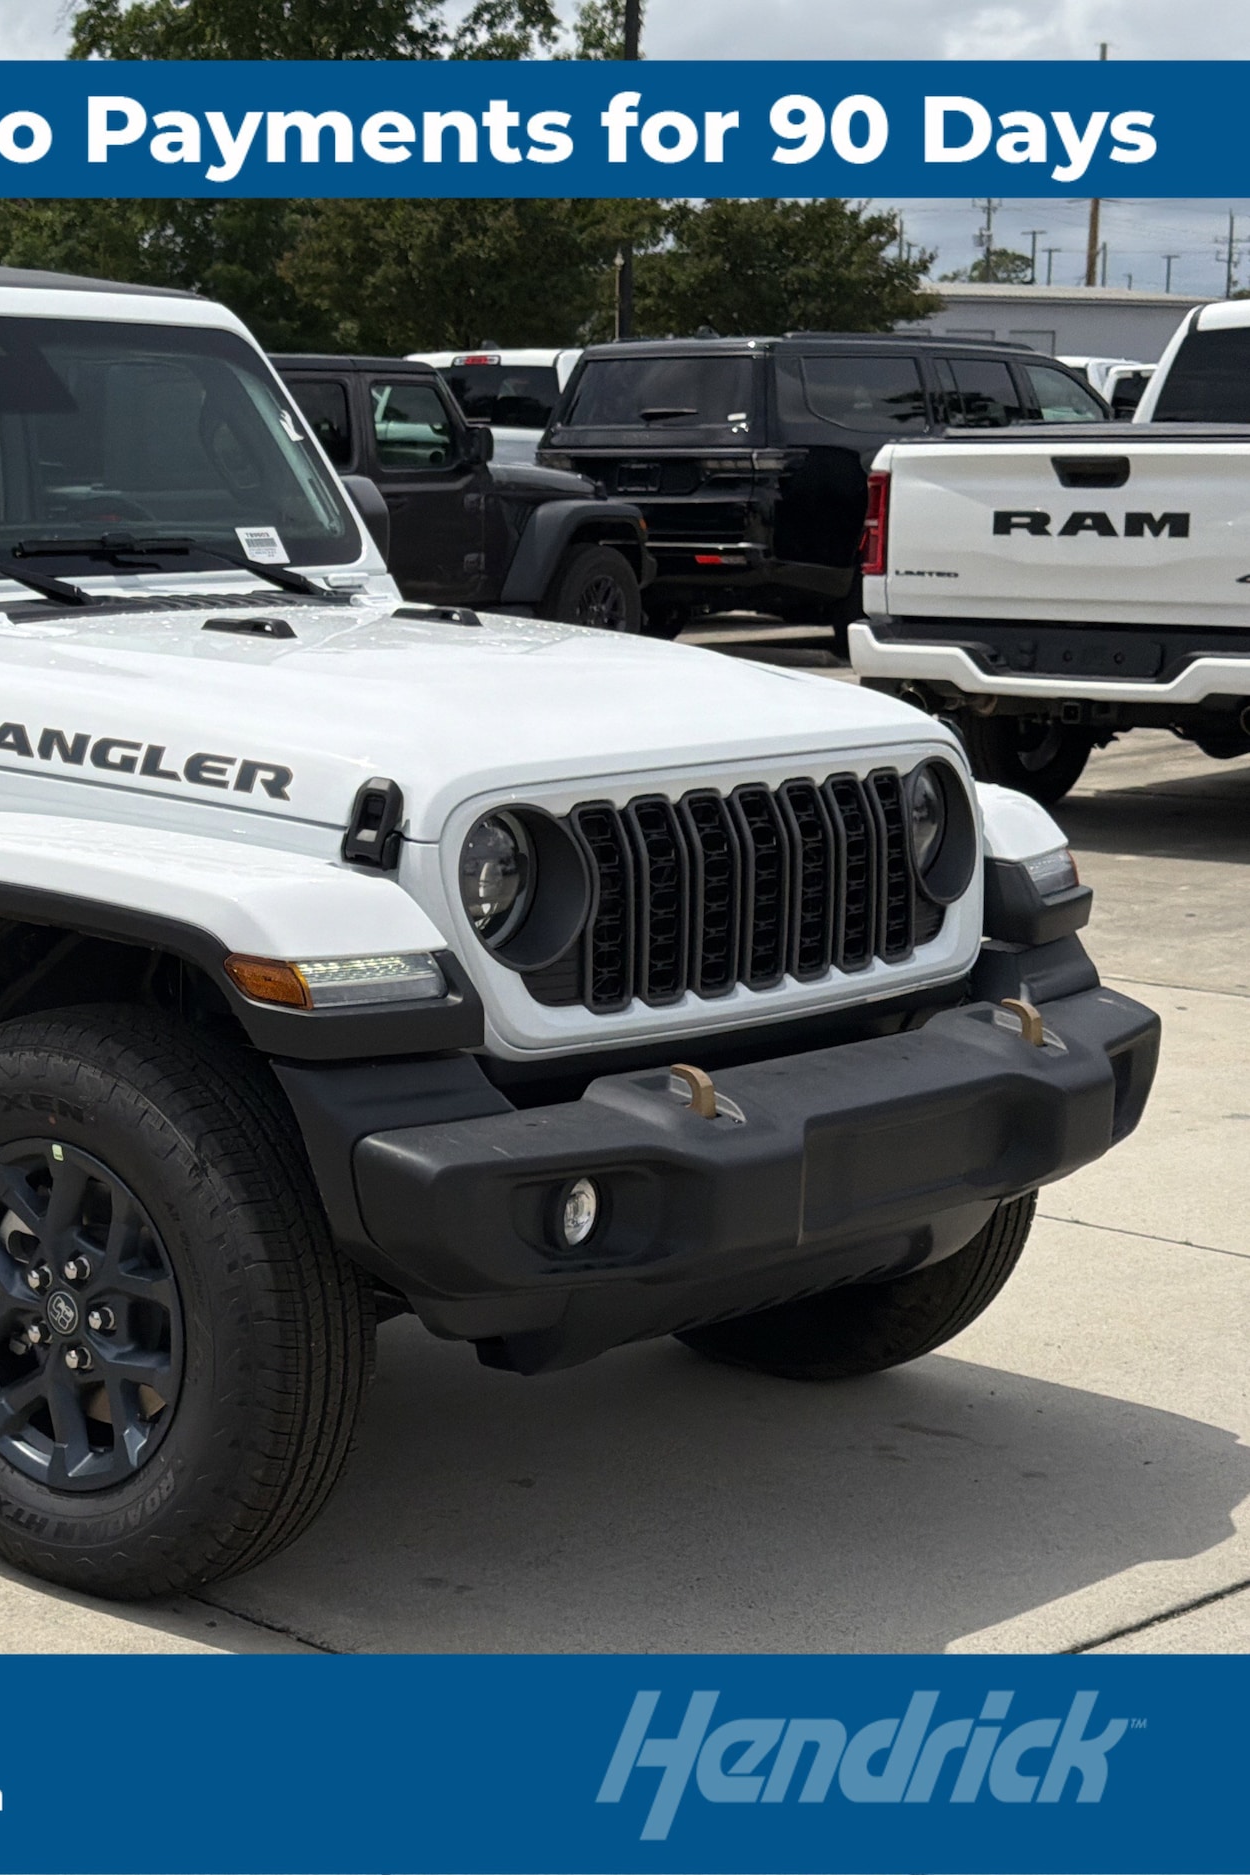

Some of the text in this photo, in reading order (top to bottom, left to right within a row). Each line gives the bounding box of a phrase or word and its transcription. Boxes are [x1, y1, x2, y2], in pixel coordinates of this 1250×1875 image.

[992, 510, 1191, 539] RAM
[894, 569, 960, 579] LIMITED
[53, 1468, 176, 1544] ROADIAN
